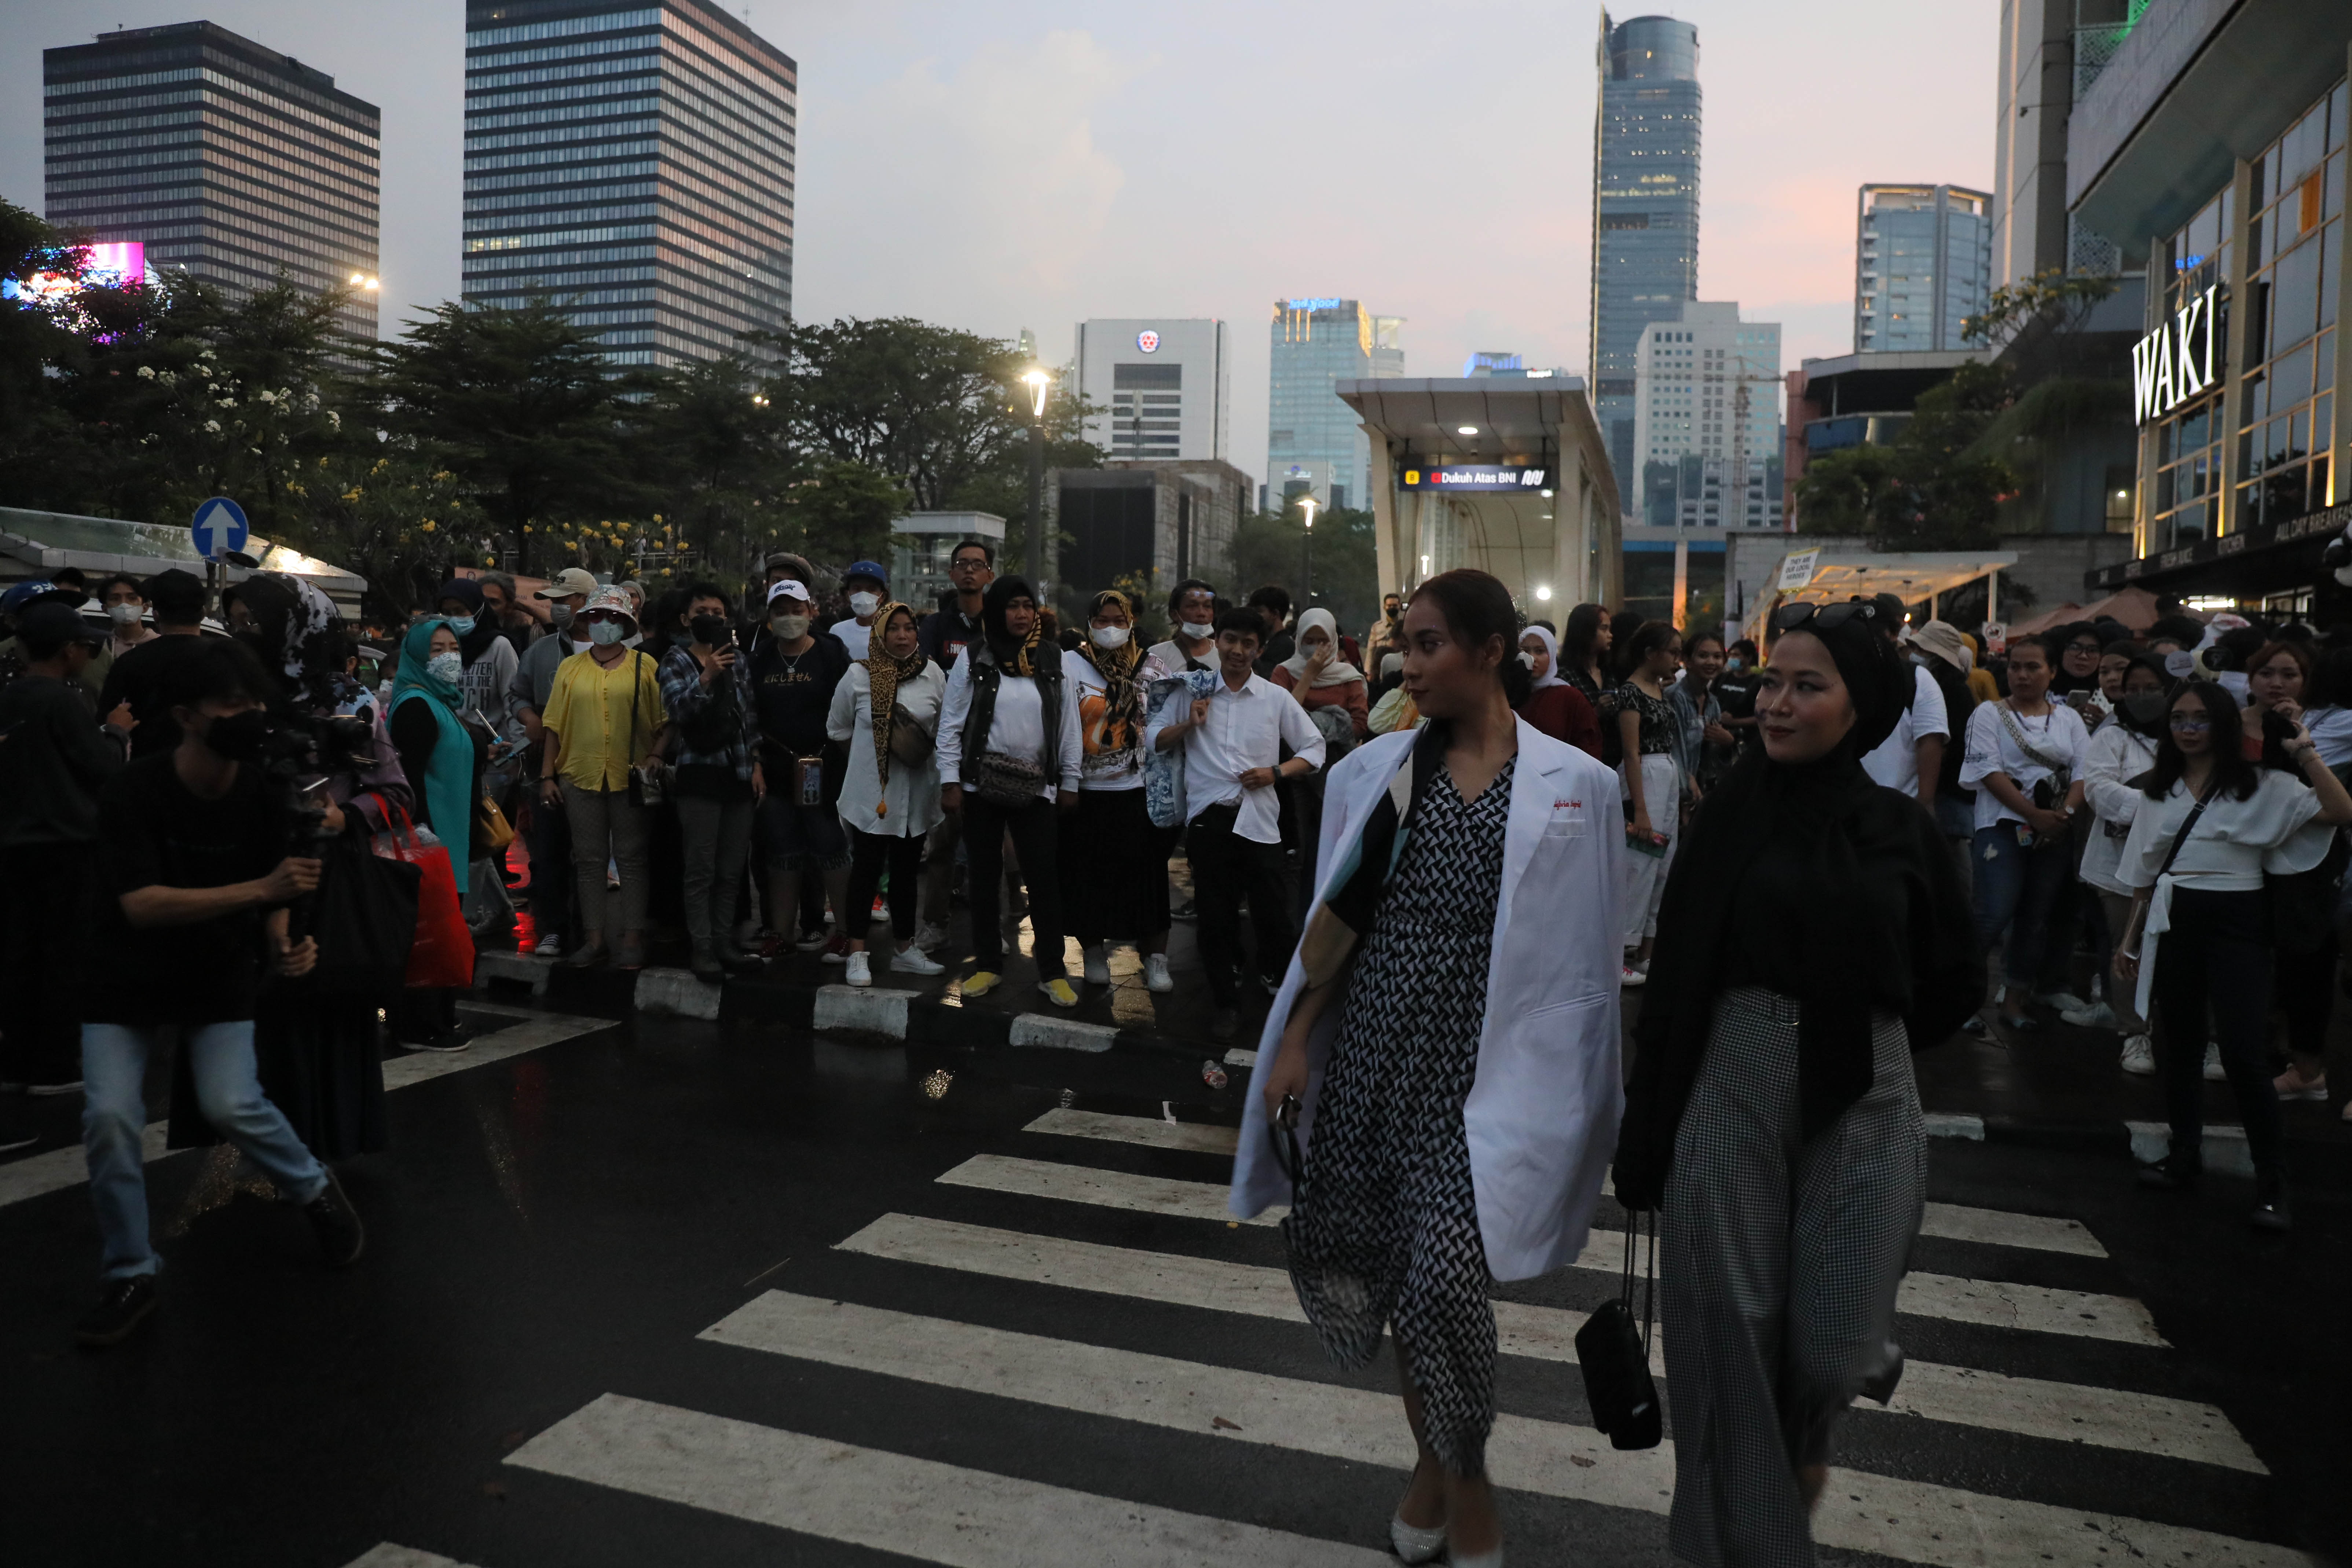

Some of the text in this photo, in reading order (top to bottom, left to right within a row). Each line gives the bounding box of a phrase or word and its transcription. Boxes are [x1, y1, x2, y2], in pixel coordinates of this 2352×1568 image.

[2132, 283, 2217, 427] WAKI
[1441, 472, 1516, 484] Dukuh Atas BNI
[477, 676, 491, 687] THE
